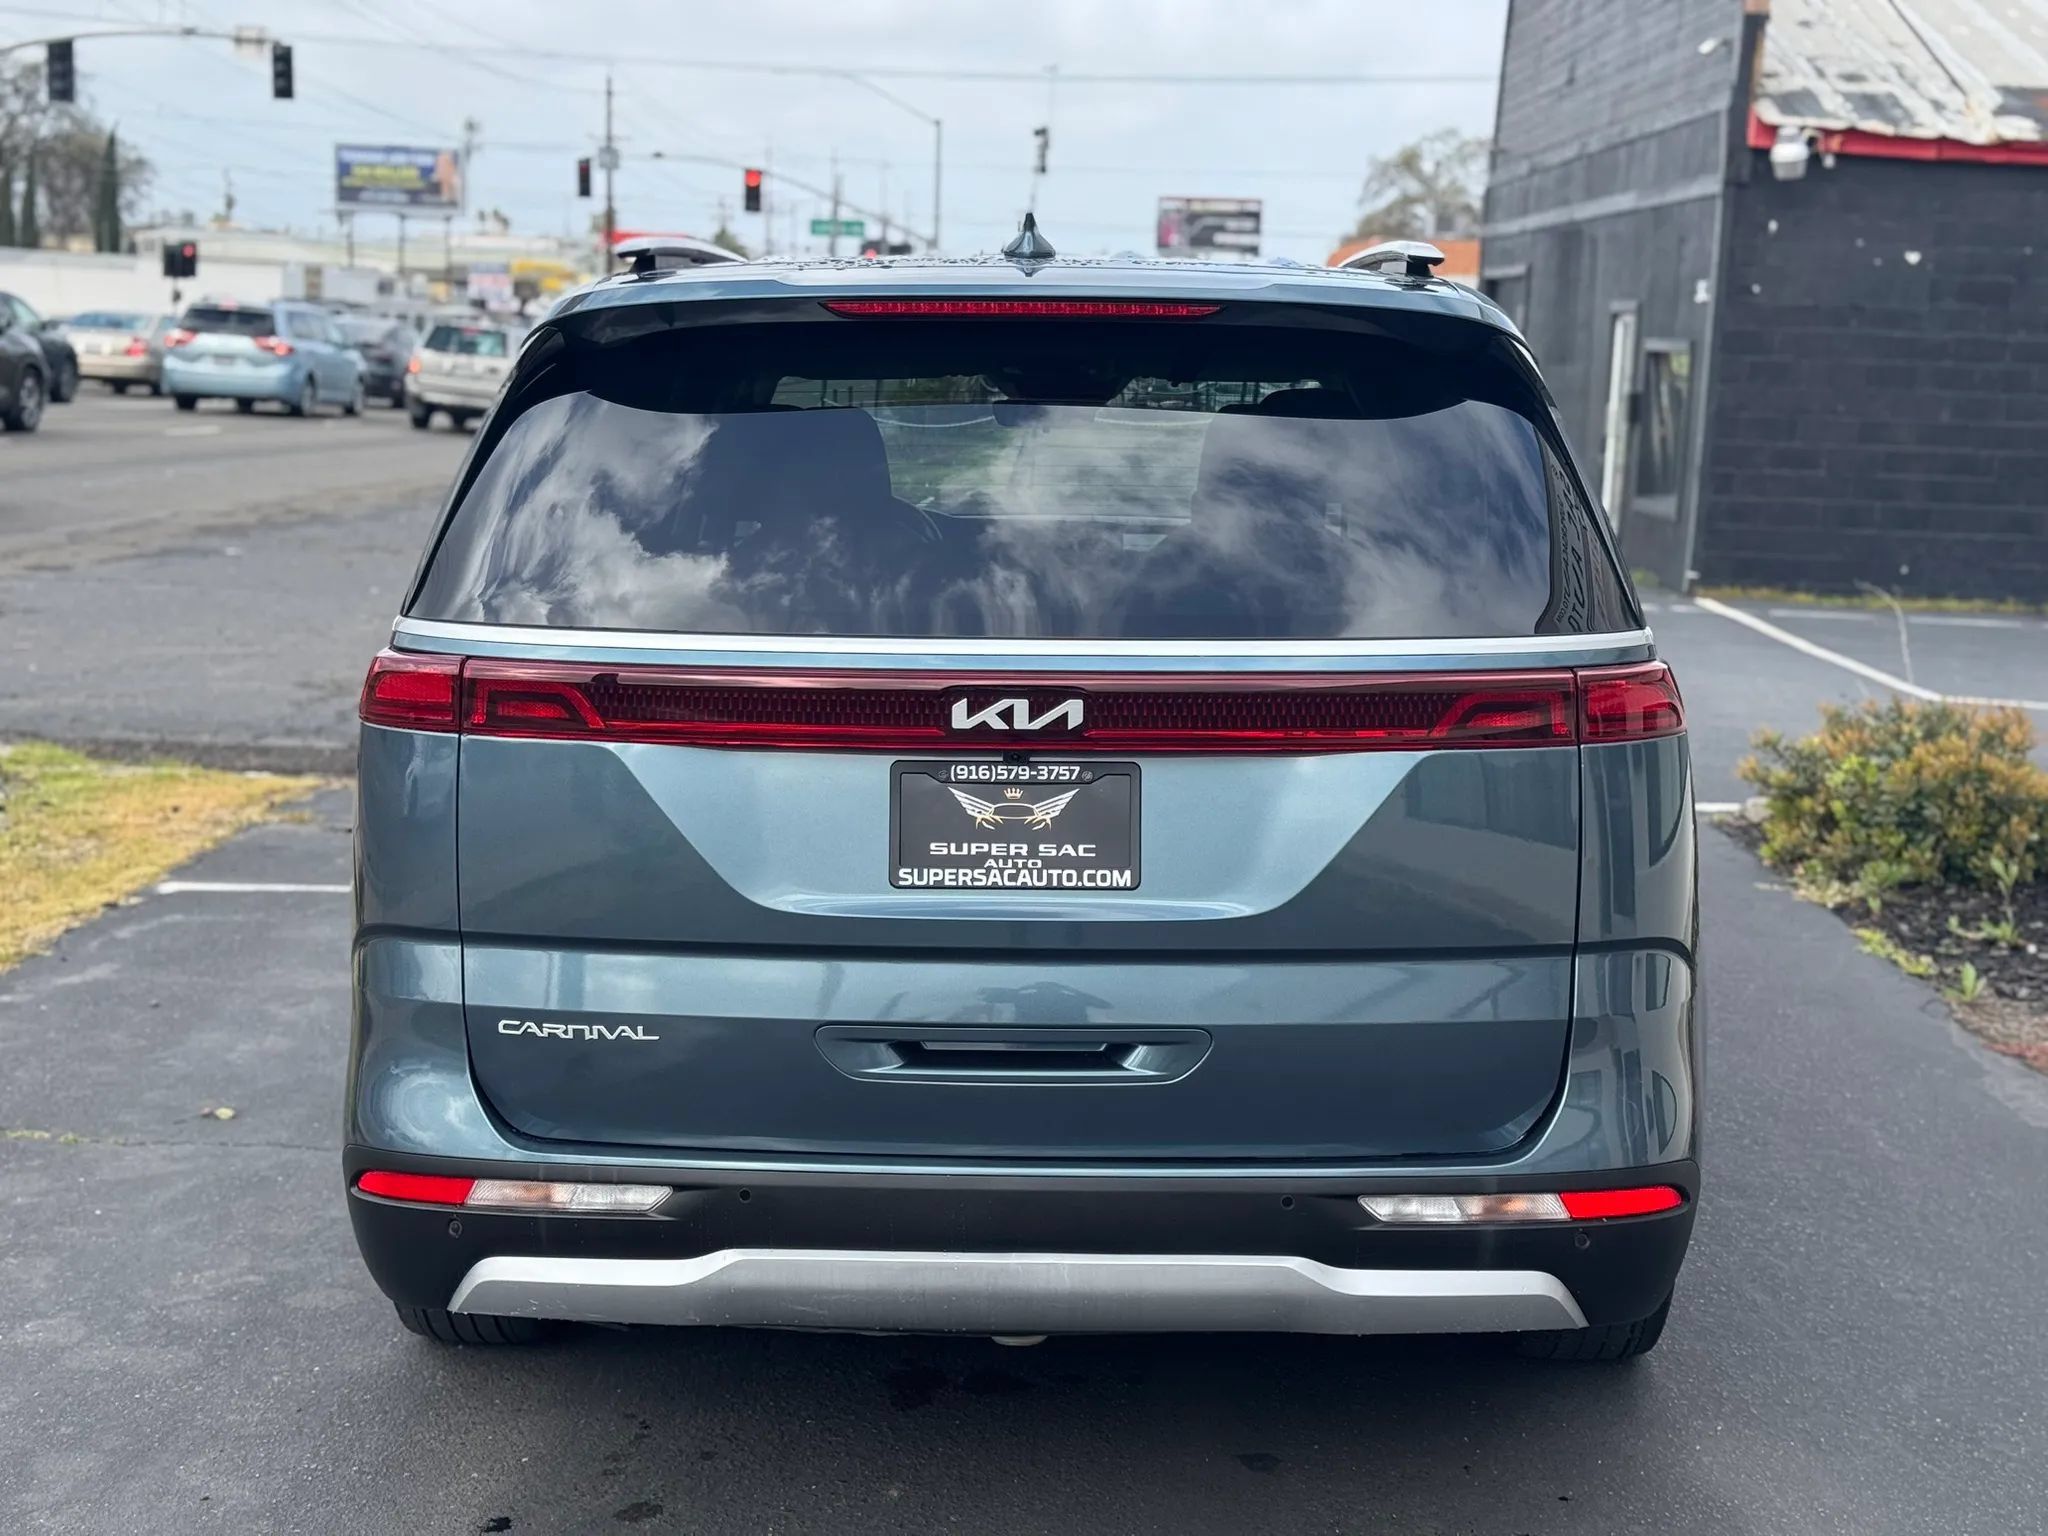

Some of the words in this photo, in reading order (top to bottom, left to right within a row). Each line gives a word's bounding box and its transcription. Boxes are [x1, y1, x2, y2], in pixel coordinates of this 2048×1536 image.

[951, 765, 1081, 782] (916)579-3757
[930, 842, 1028, 856] SUPER
[1038, 843, 1096, 857] SAC
[984, 858, 1042, 868] AUTO
[899, 868, 1131, 887] SUPERSACAUTO.COM
[498, 1019, 660, 1041] CARNIVAL
